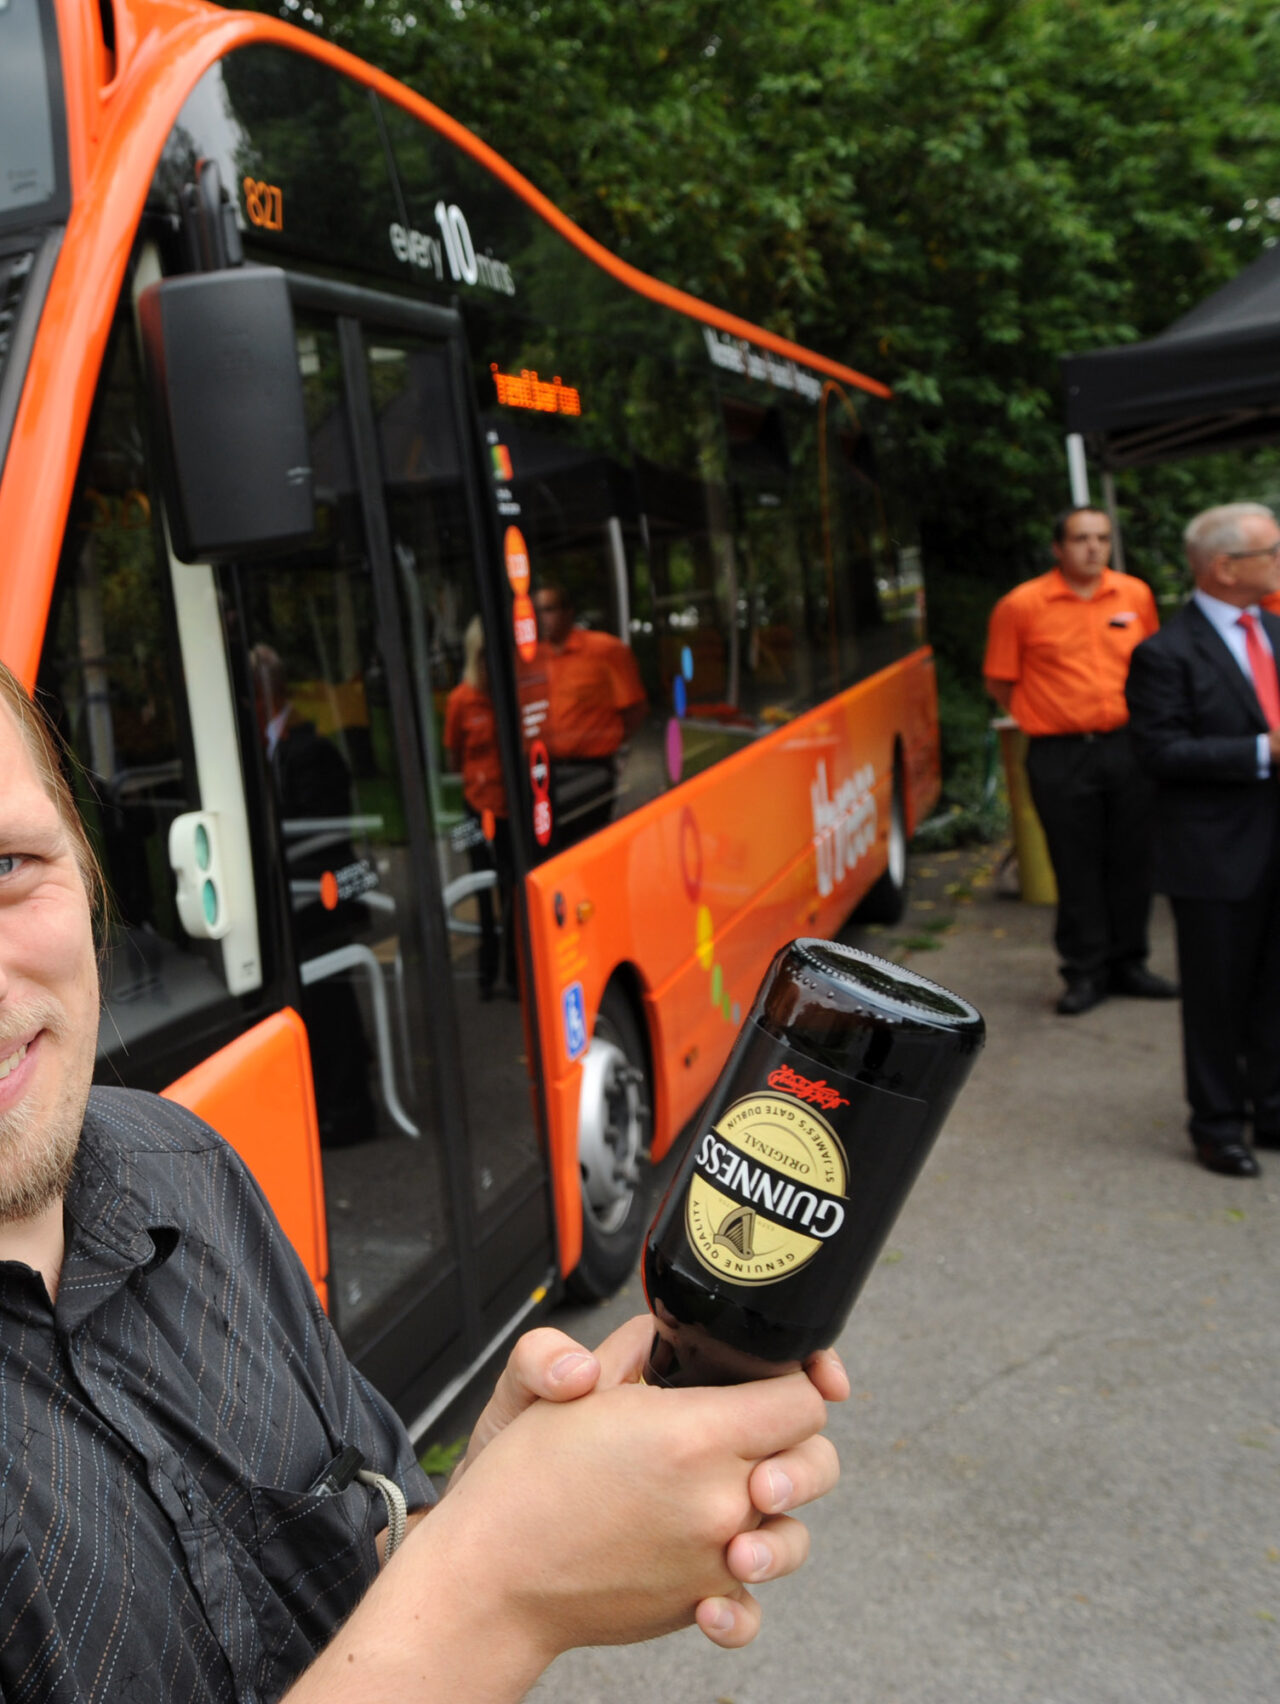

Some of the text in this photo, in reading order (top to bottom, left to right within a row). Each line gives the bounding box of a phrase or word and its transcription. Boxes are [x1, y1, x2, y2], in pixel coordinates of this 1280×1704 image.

[243, 176, 283, 231] 827
[389, 223, 443, 281] every
[434, 201, 478, 285] 10
[727, 1106, 762, 1130] DUBLIN
[766, 1105, 796, 1121] GATE
[744, 1132, 810, 1175] ORIGINAL
[696, 1134, 845, 1238] GUINNESS
[693, 1200, 796, 1273] GENUINE QUALITY
